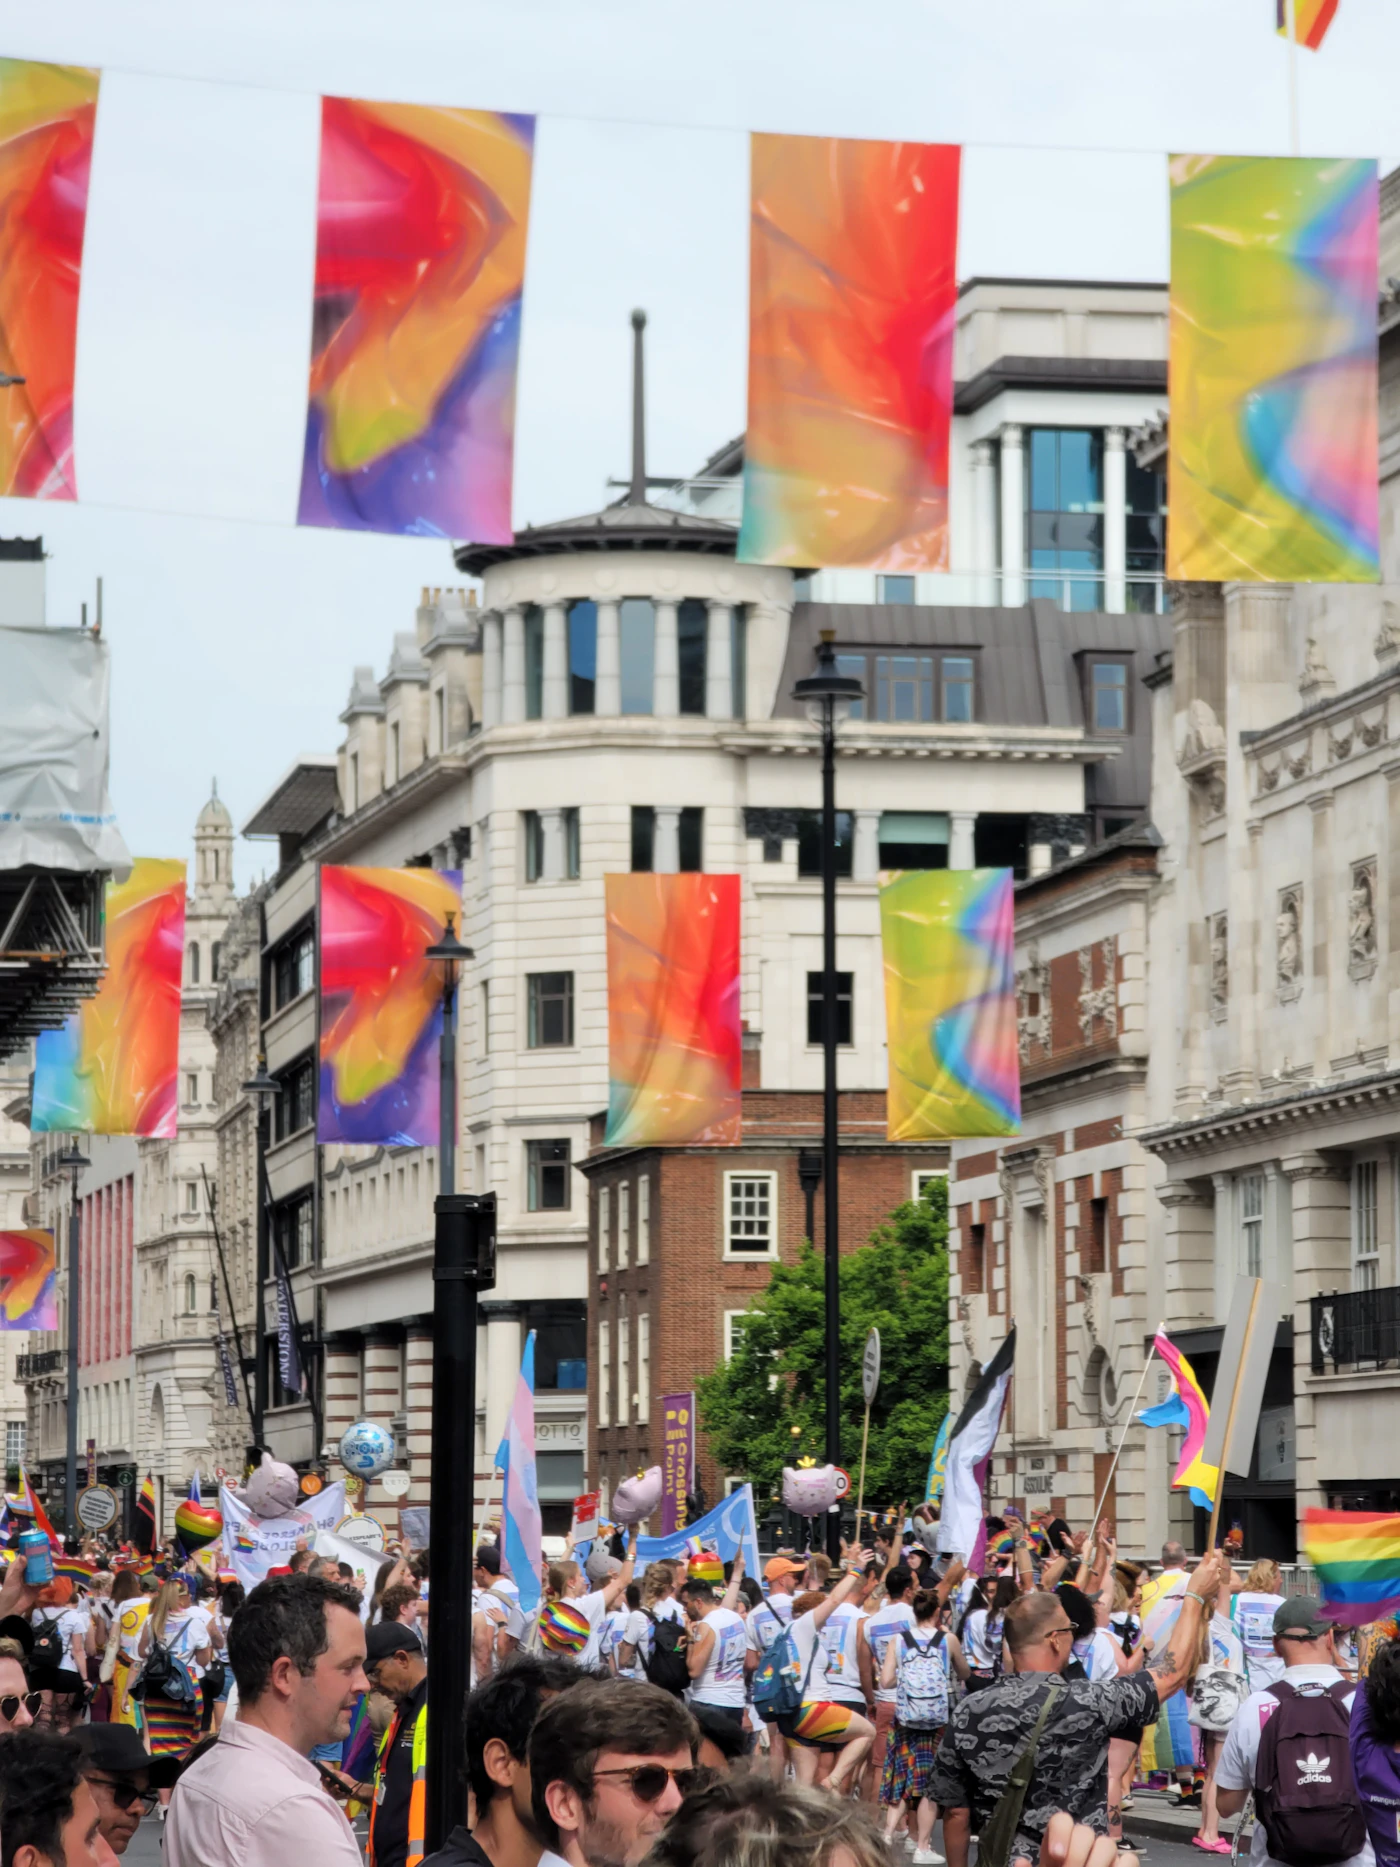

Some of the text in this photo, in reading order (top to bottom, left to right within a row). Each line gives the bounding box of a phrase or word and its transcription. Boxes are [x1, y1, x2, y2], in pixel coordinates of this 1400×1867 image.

[277, 1279, 290, 1387] WATERSTONE
[666, 1444, 676, 1496] Point
[675, 1444, 688, 1530] Crossing
[1297, 1773, 1332, 1786] adidas
